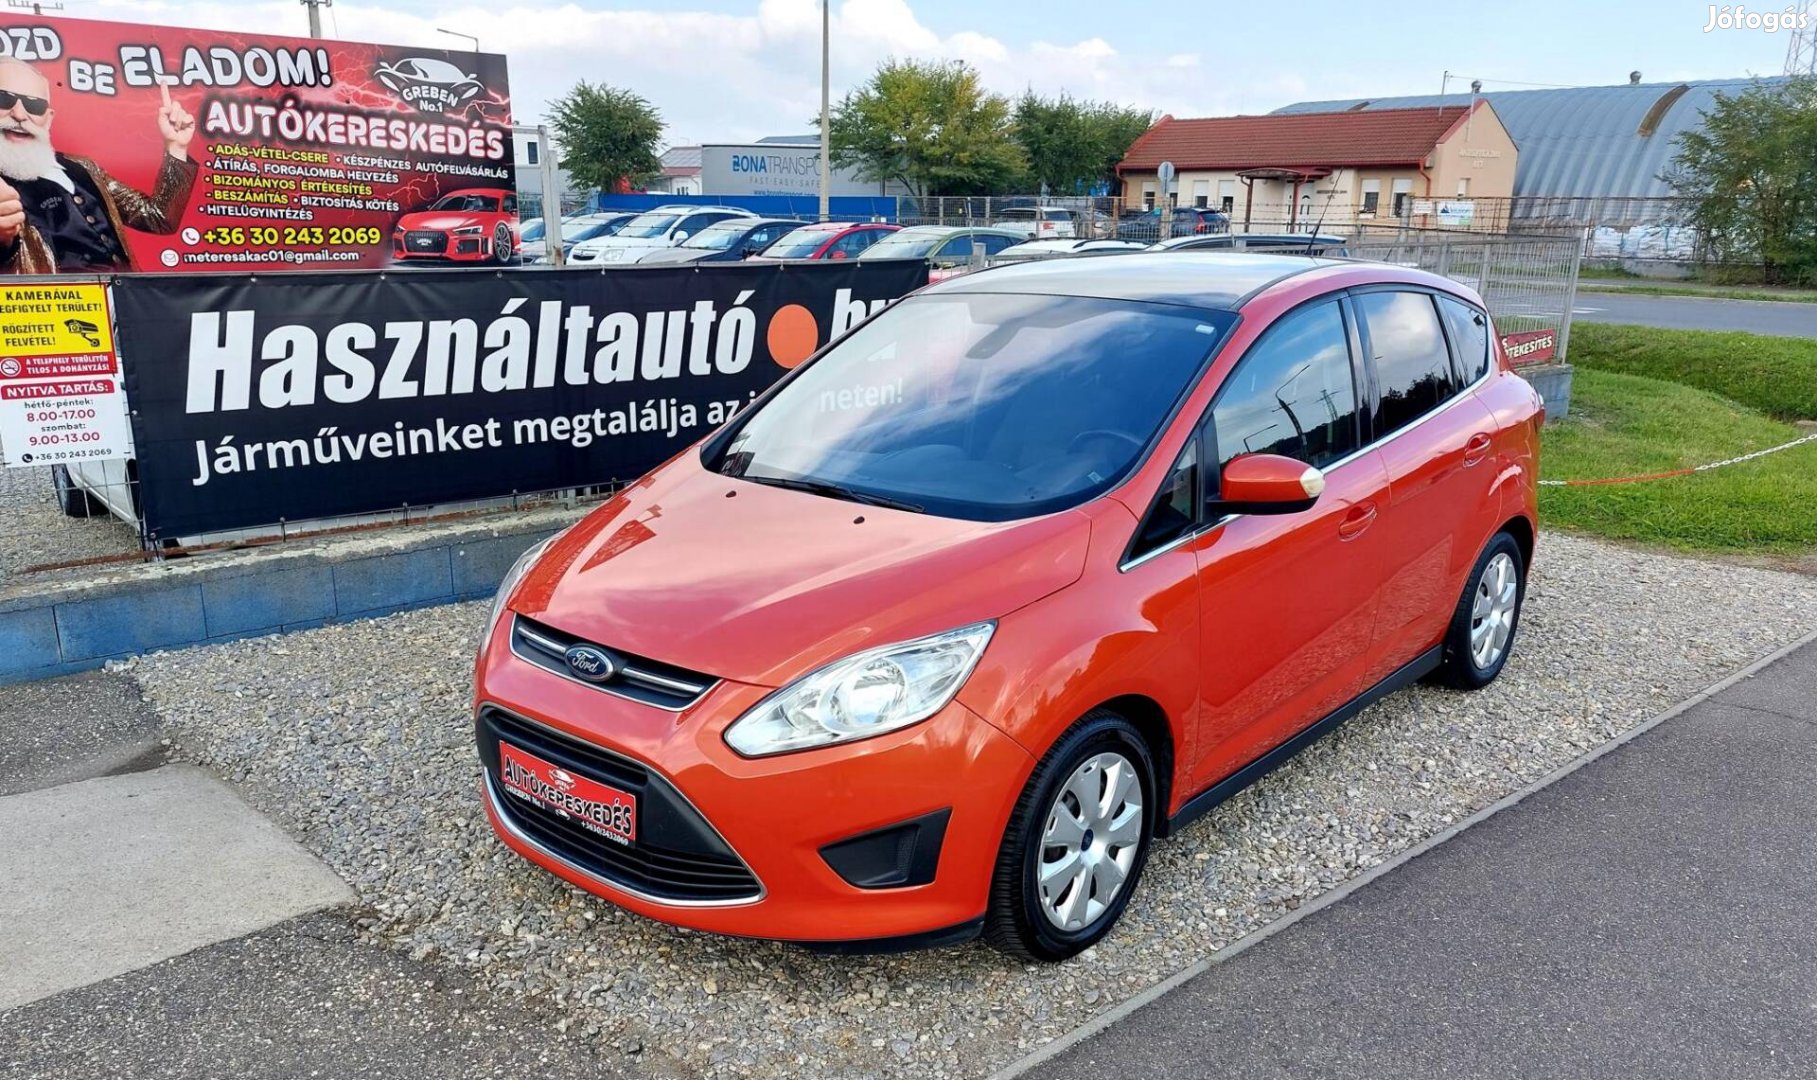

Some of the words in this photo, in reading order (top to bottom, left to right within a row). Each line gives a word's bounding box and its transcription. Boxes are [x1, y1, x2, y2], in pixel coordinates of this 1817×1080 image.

[120, 46, 332, 87] ELADOM!
[69, 60, 116, 95] BE
[402, 85, 458, 107] GREBEN
[420, 100, 443, 112] No.1
[206, 99, 505, 160] AUTÓKERESKEDÉS
[213, 157, 260, 174] ÁTÍRÁS,
[264, 163, 345, 179] FORGALOMBA
[347, 169, 399, 183] HELYEZÉS
[215, 144, 328, 163] ADÁS-VÉTEL-CSERE
[343, 154, 411, 171] KÉSZPÉNZES
[415, 161, 508, 179] AUTÓFELVÁSÁRLÁS
[213, 174, 296, 190] BIZOMÁNYOS
[301, 178, 372, 195] ÉRTÉKESÍTÉS
[214, 188, 289, 204] BESZÁMÍTÁS
[301, 193, 363, 209] BIZTOSÍTÁS
[365, 197, 399, 212] KÖTÉS
[207, 203, 313, 221] HITELÜGYINTÉZÉS
[204, 227, 246, 246] +36
[250, 227, 279, 246] 30
[284, 227, 324, 246] 243
[329, 227, 381, 246] 2069
[6, 288, 83, 301] KAMERÁVAL
[56, 302, 102, 312] TERÜLET!
[2, 322, 55, 334] RÖGZÍTETT
[5, 335, 56, 347] FELVÉTEL!
[33, 356, 69, 365] TELEPHELY
[72, 353, 109, 362] TERÜLETÉN
[186, 291, 754, 413] Használtautó
[27, 367, 50, 375] TILOS
[52, 365, 58, 373] A
[60, 363, 110, 373] DOHÁNYZÁS!
[6, 385, 57, 398] NYITVA
[58, 381, 109, 395] TARTÁS:
[24, 397, 94, 409] hétfő-péntek:
[26, 409, 96, 422] 8.00-17.00
[41, 423, 86, 432] szombat:
[29, 432, 100, 446] 9.00-13.00
[192, 418, 501, 486] Járműveinket
[513, 399, 697, 446] megtalálja
[707, 400, 742, 425] az
[54, 452, 67, 460] 30
[69, 450, 87, 458] 243
[89, 448, 112, 456] 2069
[572, 650, 600, 673] Ford
[504, 754, 633, 836] AUTÓKERESKEDÉS
